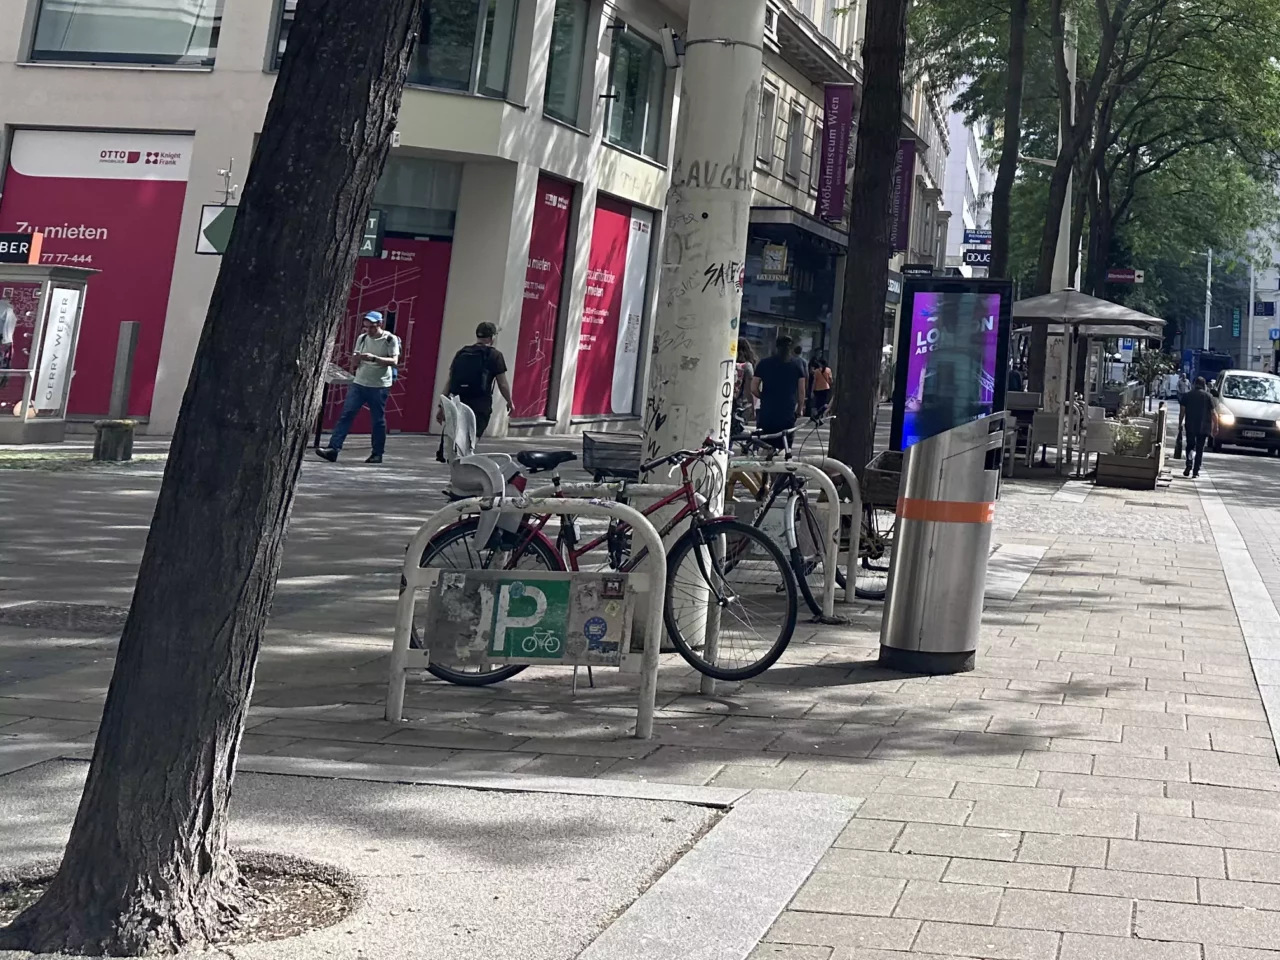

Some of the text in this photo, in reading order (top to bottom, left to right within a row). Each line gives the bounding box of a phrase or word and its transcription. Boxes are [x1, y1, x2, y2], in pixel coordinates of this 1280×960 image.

[100, 150, 126, 159] OTTO
[820, 96, 840, 212] Möbelmuseum Wien
[43, 223, 108, 240] mieten
[55, 253, 92, 263] 77-444
[55, 297, 68, 347] WEBER
[45, 353, 58, 401] GERRY
[492, 584, 548, 651] P
